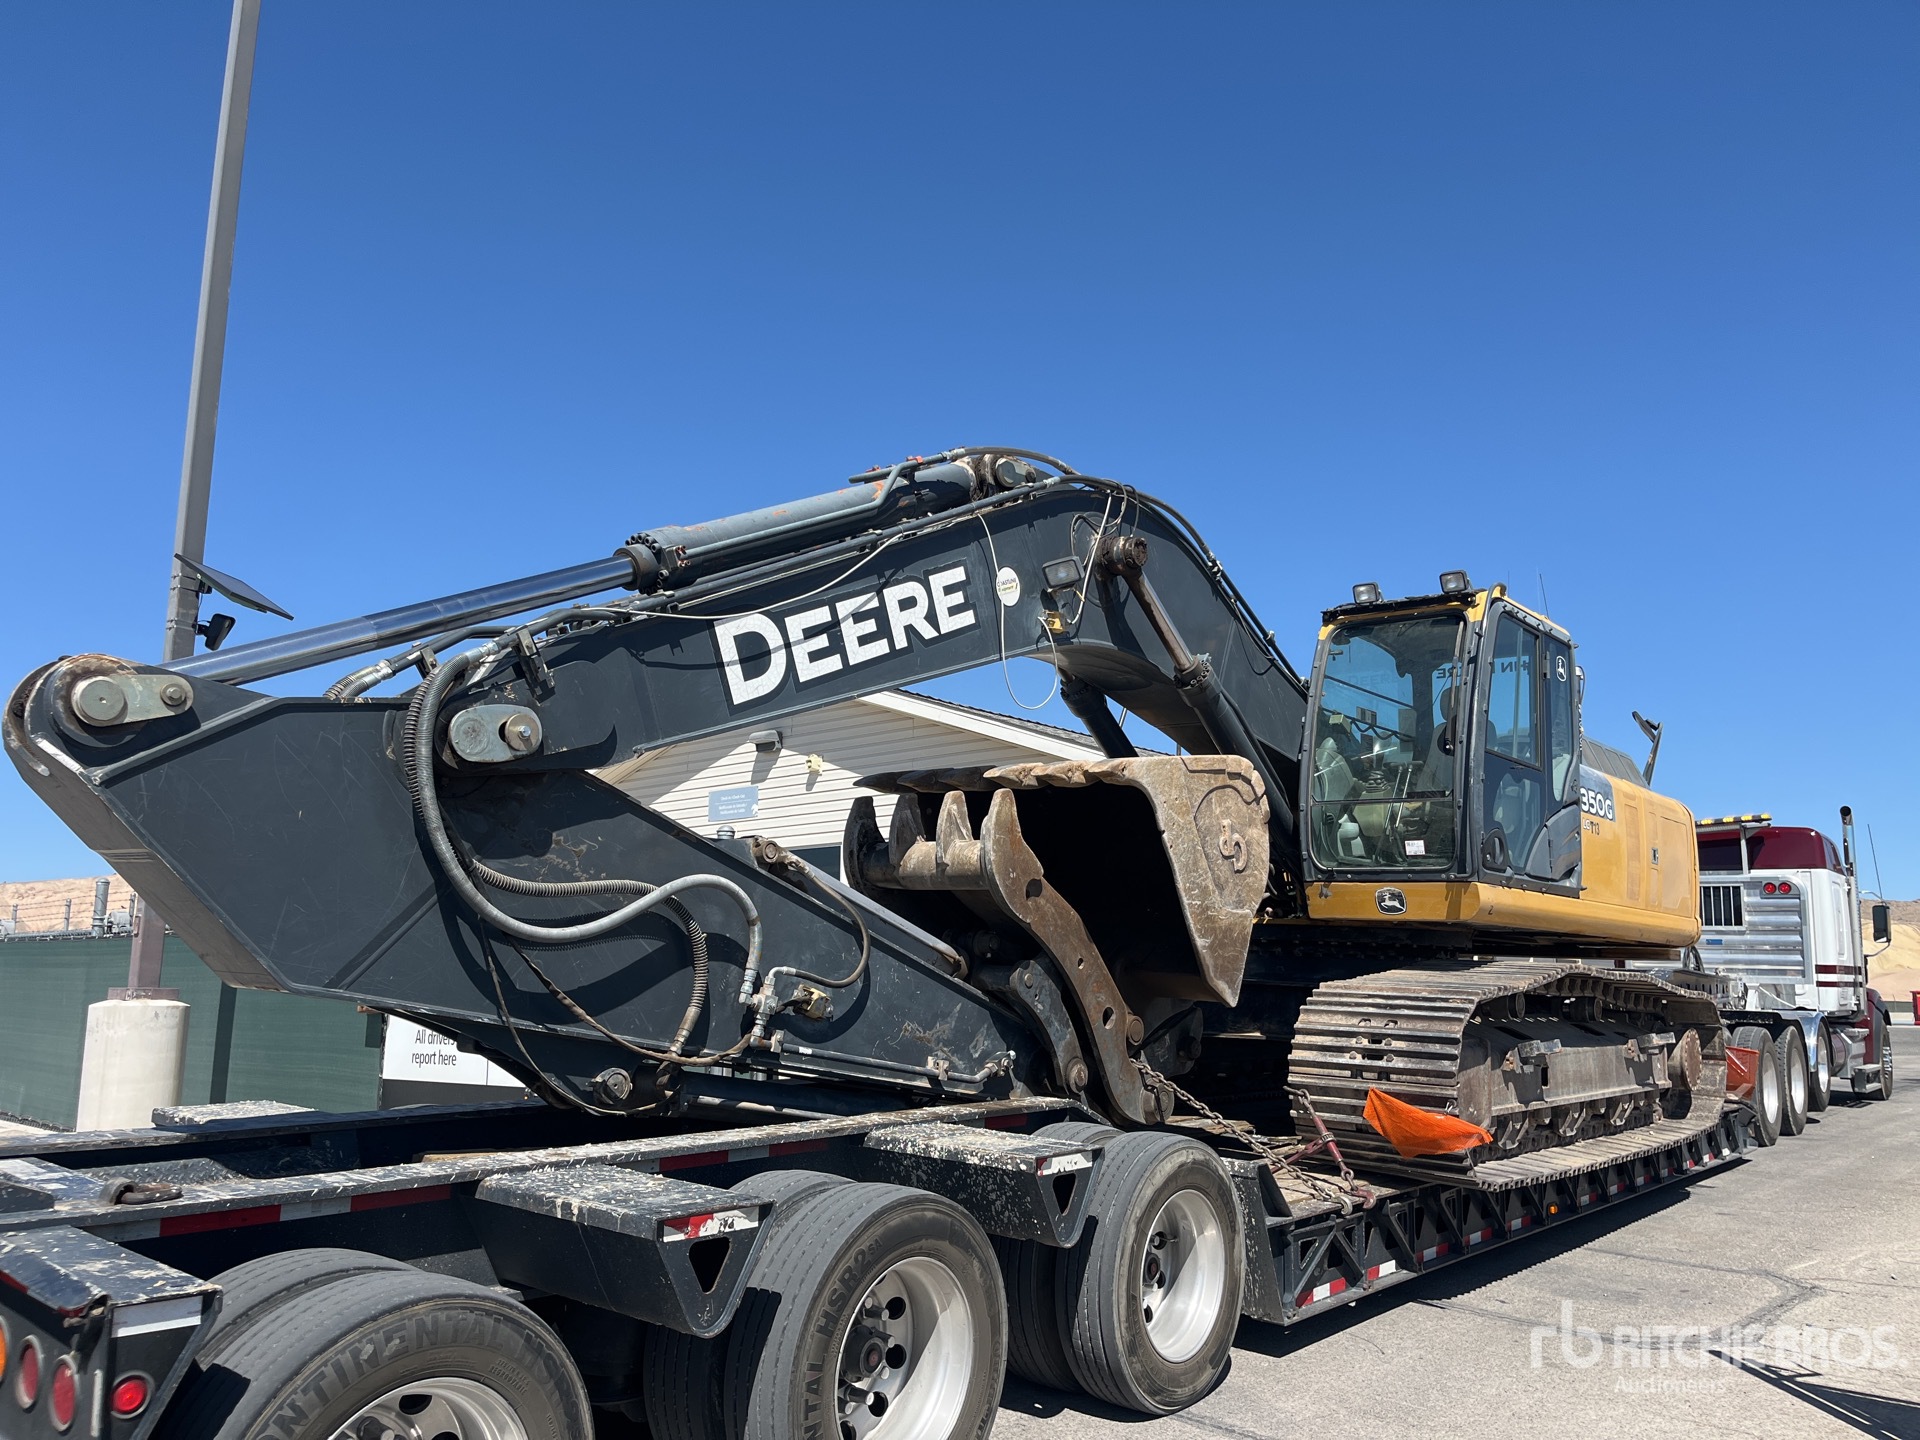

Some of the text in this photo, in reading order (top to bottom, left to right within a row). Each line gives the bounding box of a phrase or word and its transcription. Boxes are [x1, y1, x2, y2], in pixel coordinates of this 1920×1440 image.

[714, 566, 975, 706] DEERE
[1580, 787, 1613, 820] 350G
[412, 1050, 457, 1068] report here
[415, 1029, 456, 1046] All drivers
[814, 1246, 872, 1339] HSR2
[256, 1308, 503, 1440] NTINENTAL
